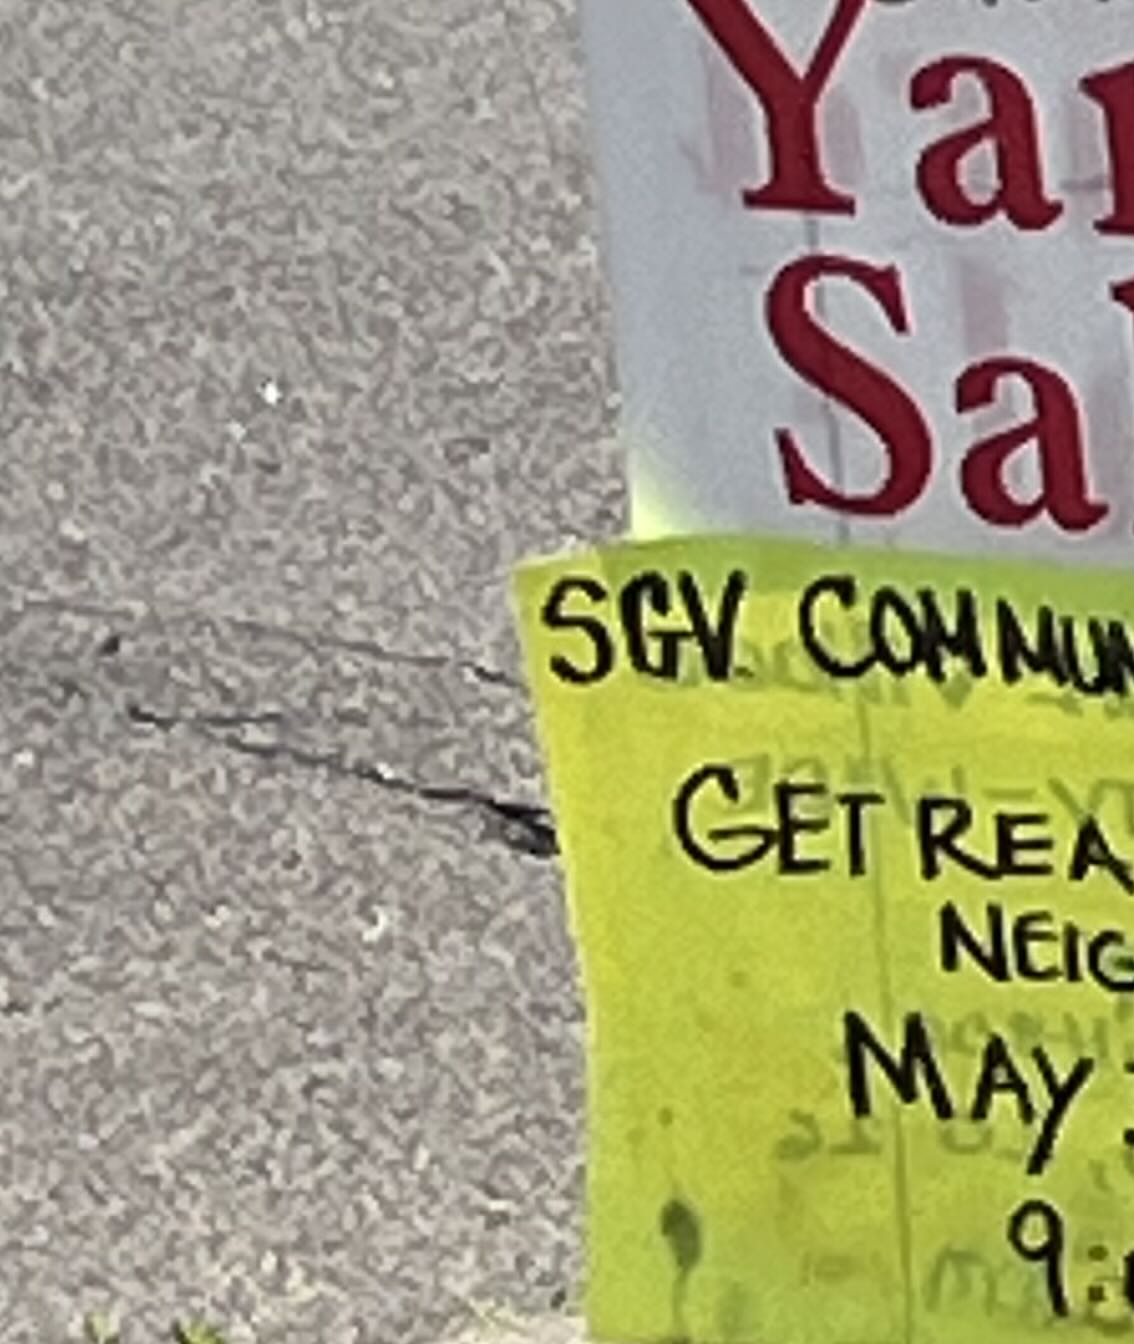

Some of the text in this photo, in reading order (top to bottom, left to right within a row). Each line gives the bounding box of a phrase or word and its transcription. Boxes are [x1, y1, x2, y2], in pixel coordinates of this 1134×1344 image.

[542, 570, 746, 686] SGV
[673, 764, 886, 877] GET
[843, 1010, 1095, 1176] MAY
